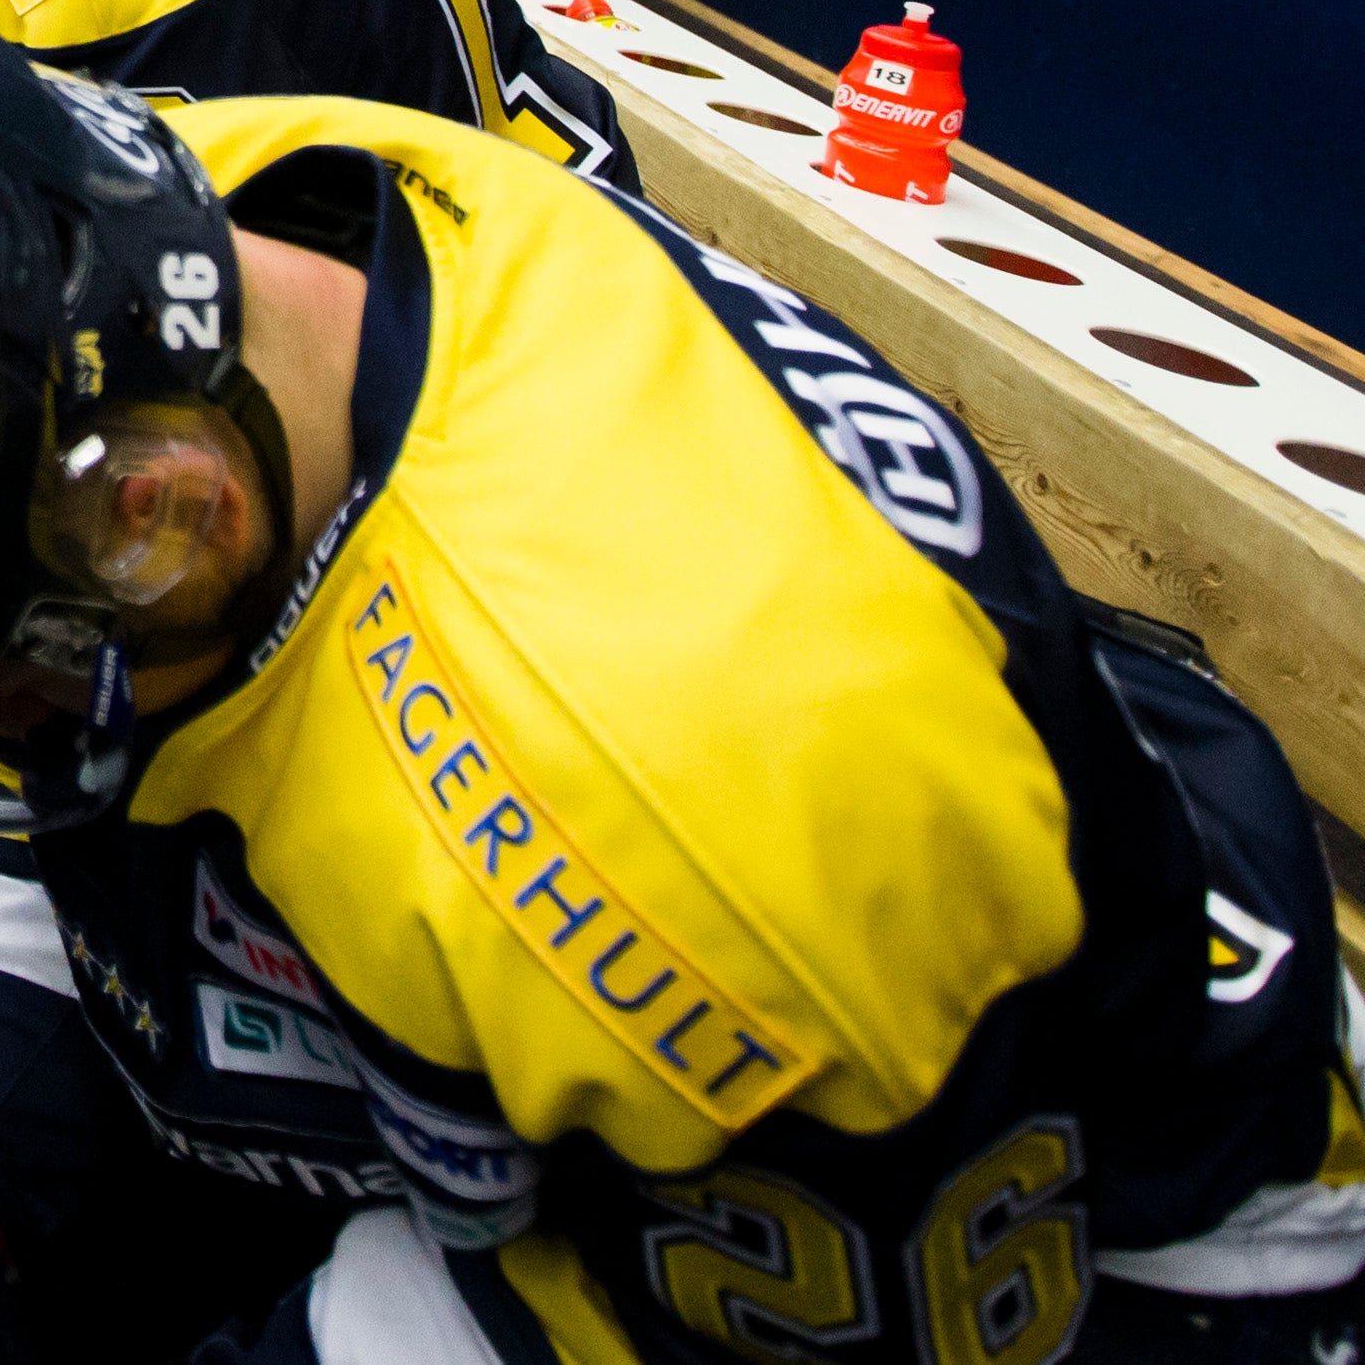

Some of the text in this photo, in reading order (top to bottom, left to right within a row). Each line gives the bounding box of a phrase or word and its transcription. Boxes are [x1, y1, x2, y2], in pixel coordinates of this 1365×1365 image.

[853, 86, 937, 129] ENERVIT
[872, 66, 907, 86] 18
[161, 250, 221, 351] 26
[353, 582, 782, 1095] FAGERHULT
[640, 1115, 1097, 1365] 26
